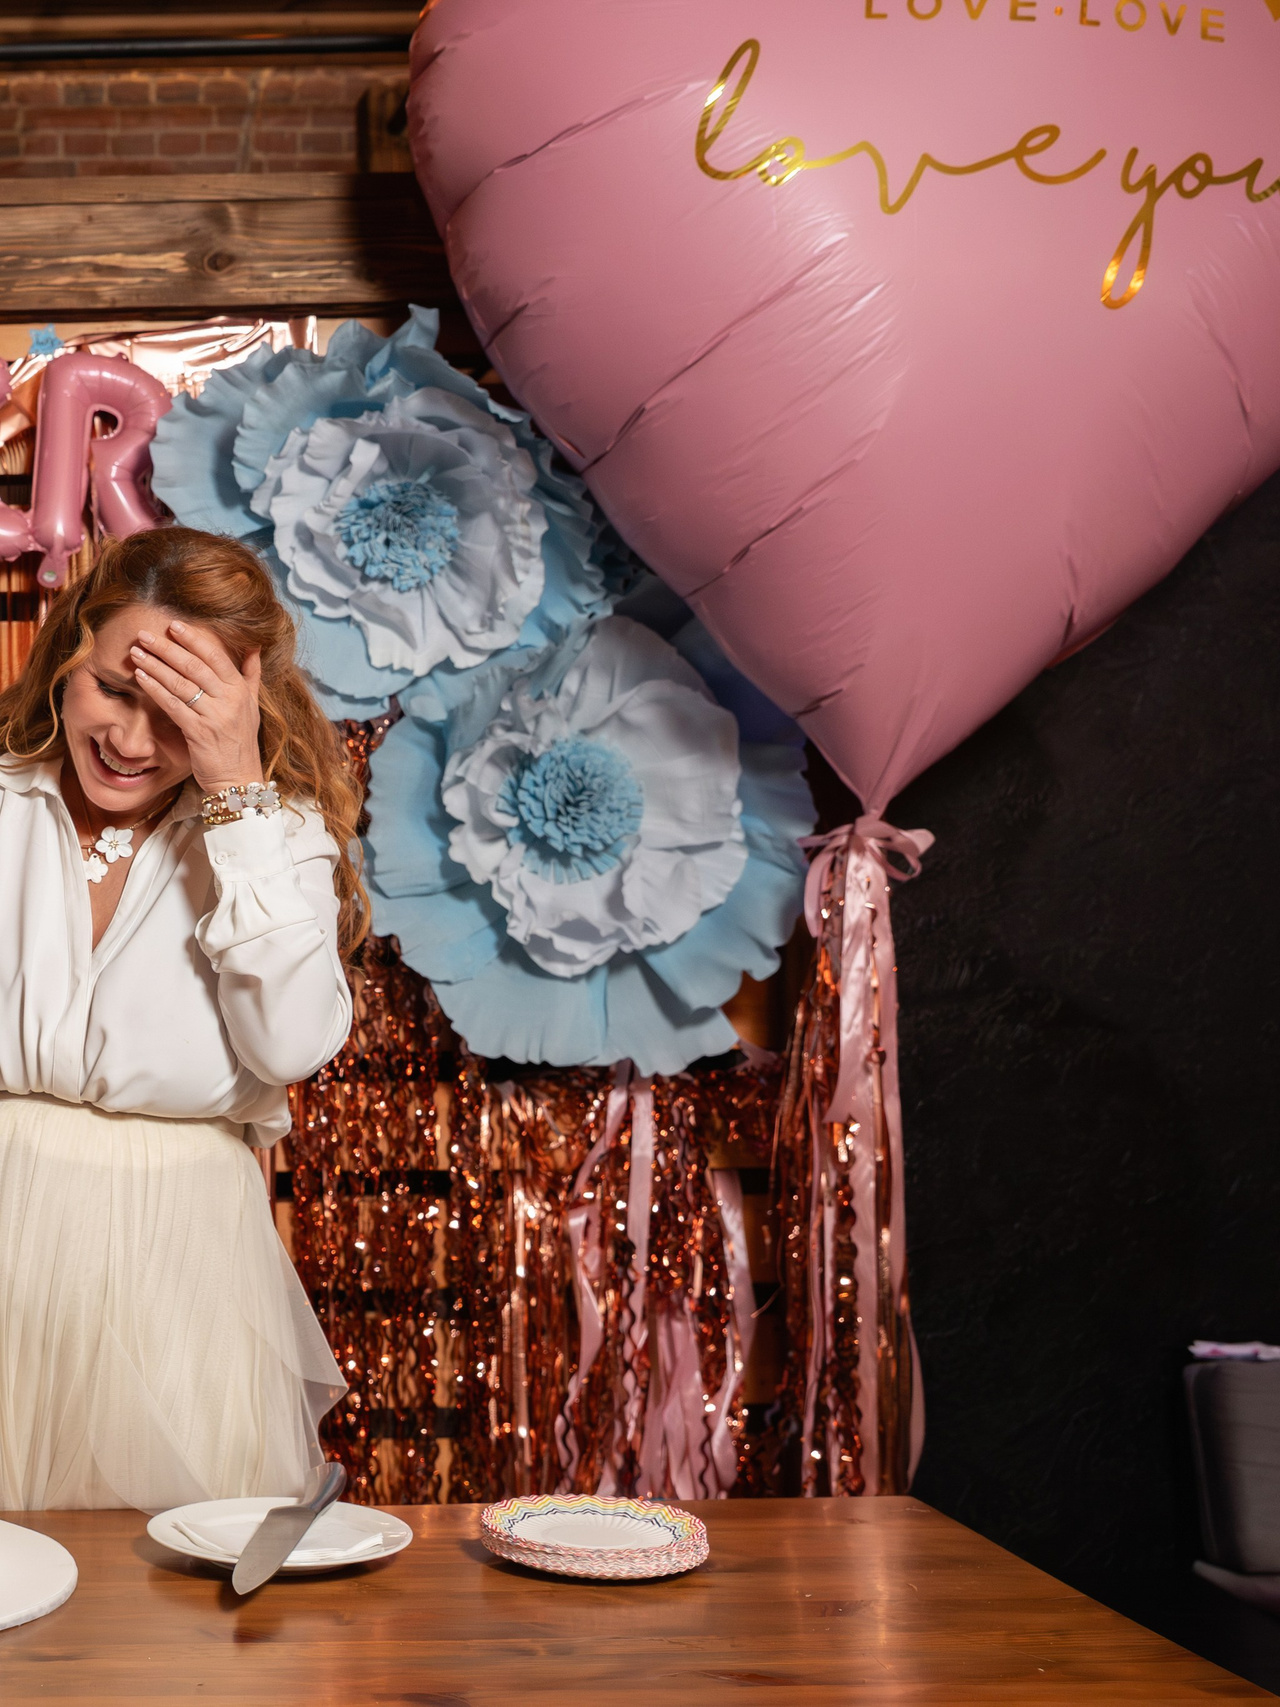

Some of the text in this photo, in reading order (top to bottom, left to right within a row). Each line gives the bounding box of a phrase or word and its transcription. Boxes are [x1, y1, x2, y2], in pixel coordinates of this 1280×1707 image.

[864, 0, 1225, 43] LOVE LOVE
[695, 38, 1108, 215] love
